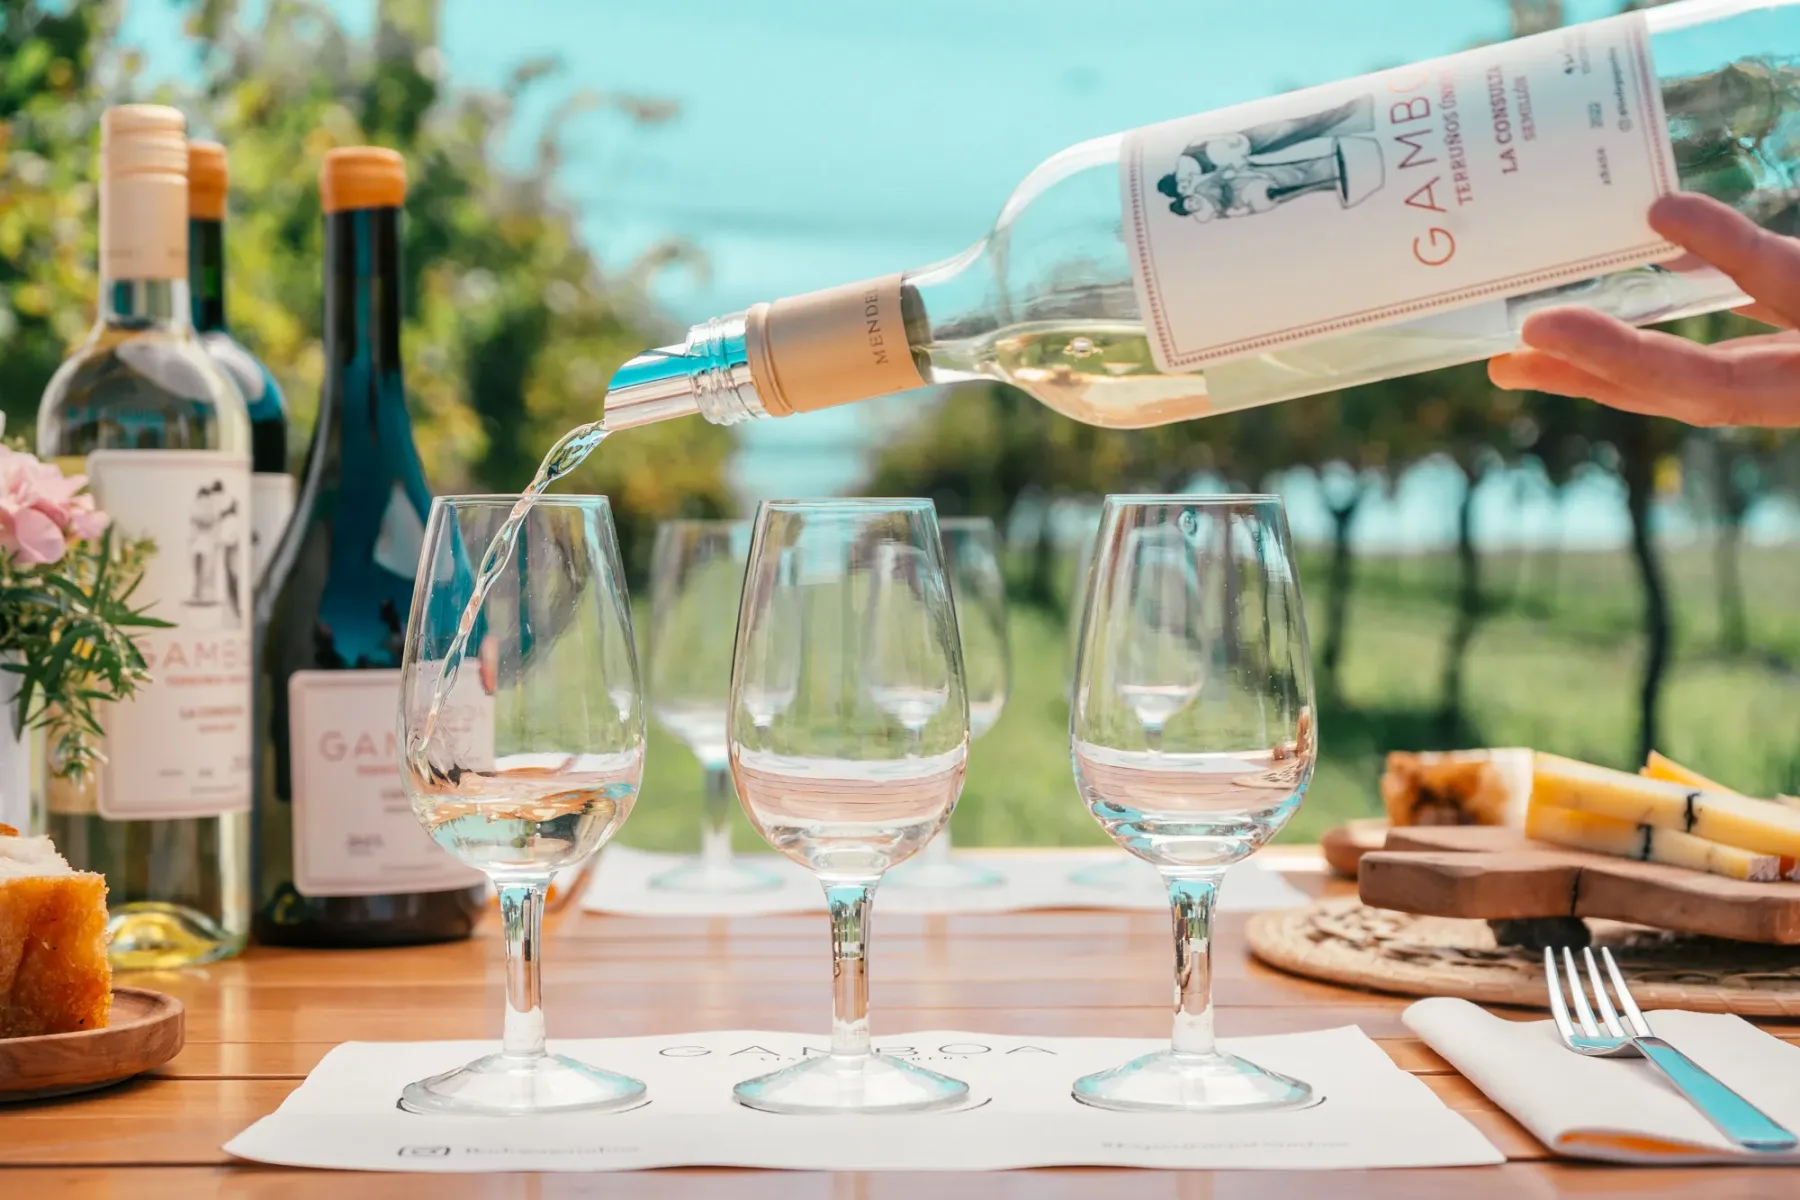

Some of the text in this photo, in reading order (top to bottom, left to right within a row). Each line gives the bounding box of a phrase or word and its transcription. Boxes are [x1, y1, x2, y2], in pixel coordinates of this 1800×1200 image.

[1442, 112, 1474, 206] TERRUÑOS
[1487, 66, 1520, 175] LA CONSULTA
